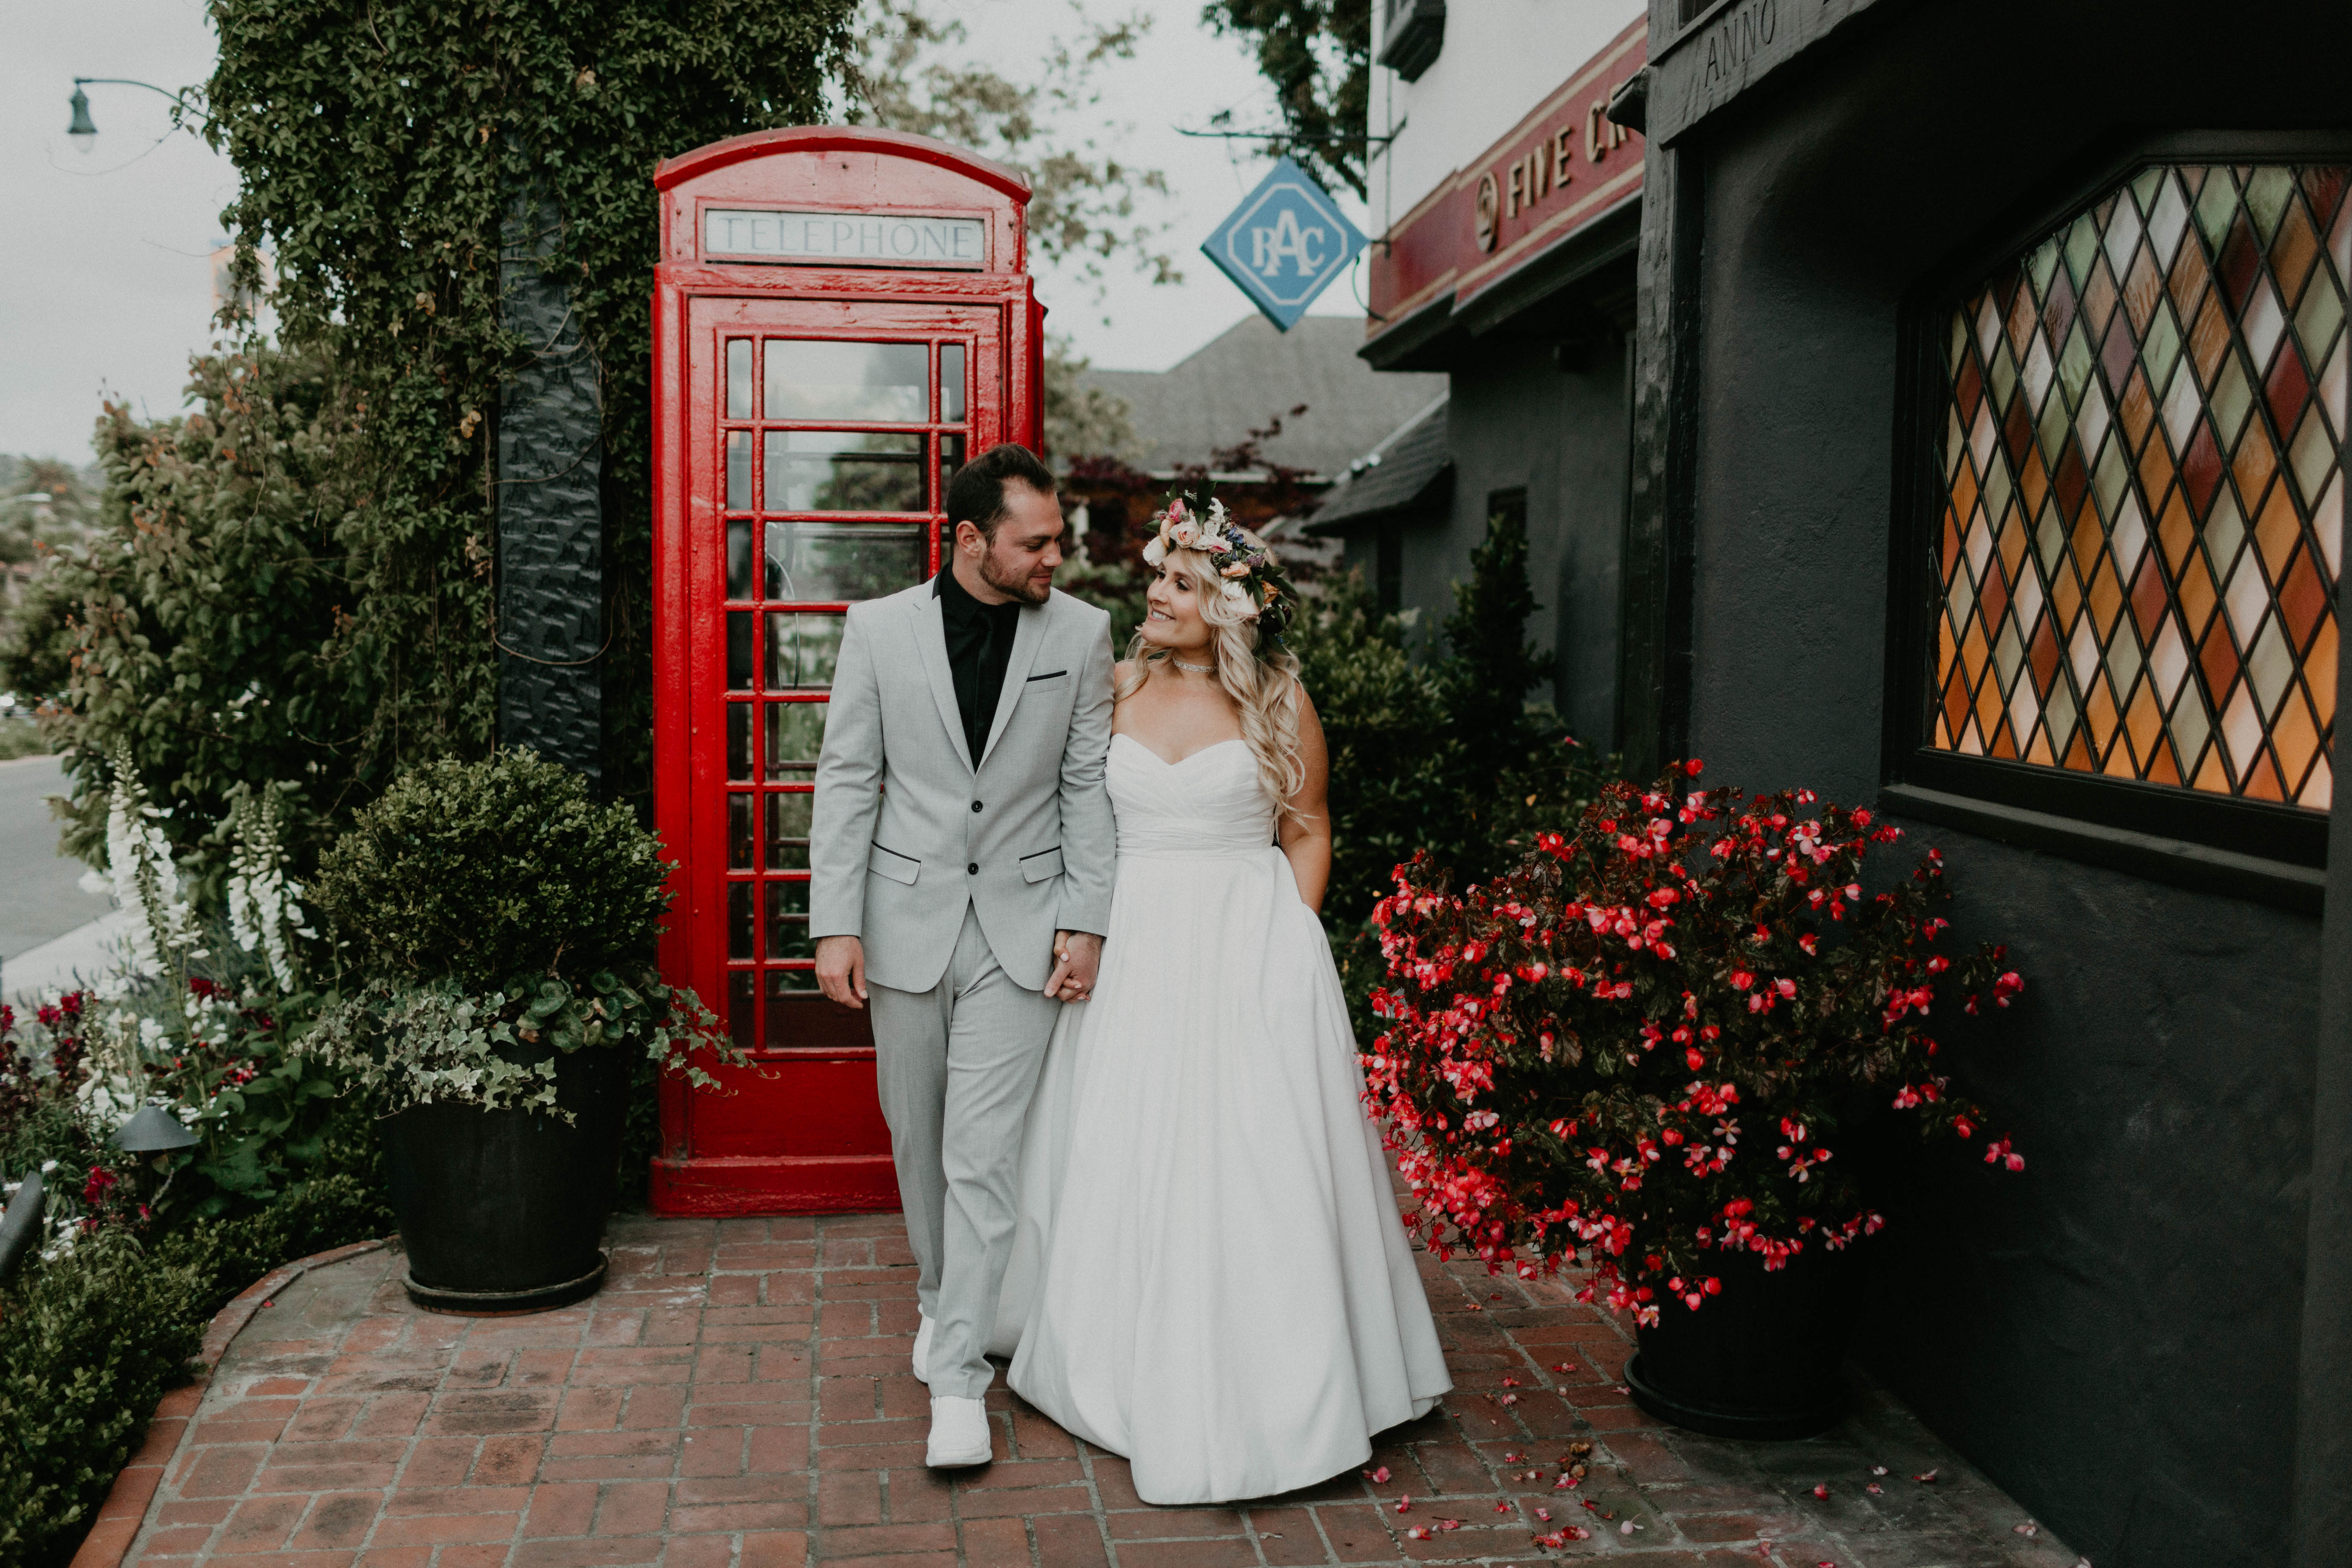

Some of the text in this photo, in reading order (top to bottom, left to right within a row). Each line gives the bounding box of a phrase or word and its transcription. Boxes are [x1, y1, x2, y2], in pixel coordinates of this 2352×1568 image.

[1704, 0, 1776, 88] ANNO
[1506, 124, 1571, 219] FIVE
[718, 217, 973, 258] TELEPHONE
